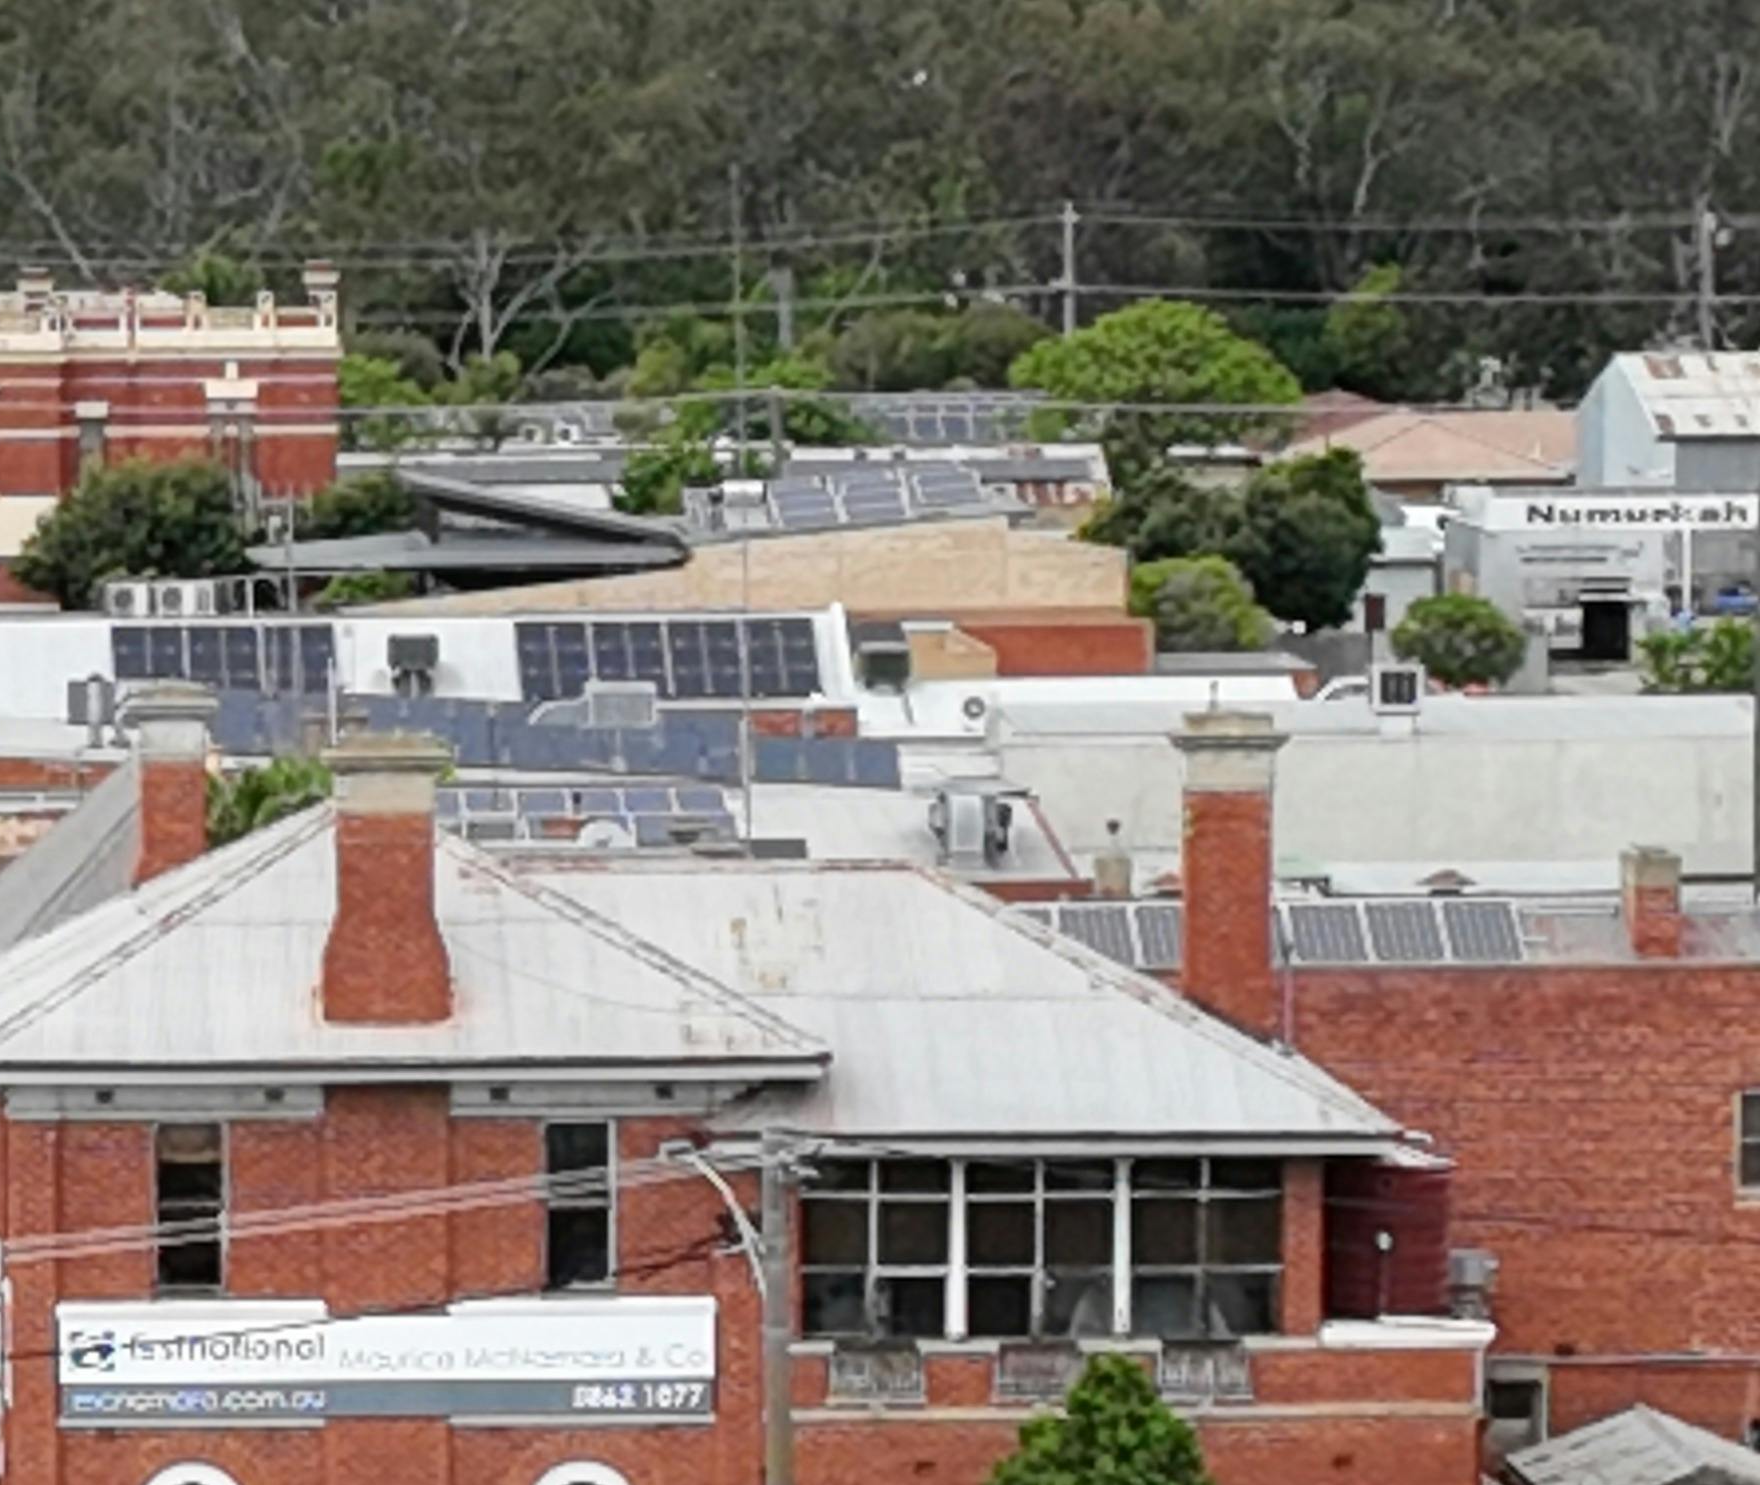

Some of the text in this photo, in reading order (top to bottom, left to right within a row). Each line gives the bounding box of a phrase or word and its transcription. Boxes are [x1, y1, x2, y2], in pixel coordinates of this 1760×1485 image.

[1527, 502, 1748, 524] Numurkah
[339, 1347, 455, 1371] Maurice
[635, 1346, 656, 1368] &
[666, 1343, 707, 1368] Co
[643, 1383, 705, 1408] 1077
